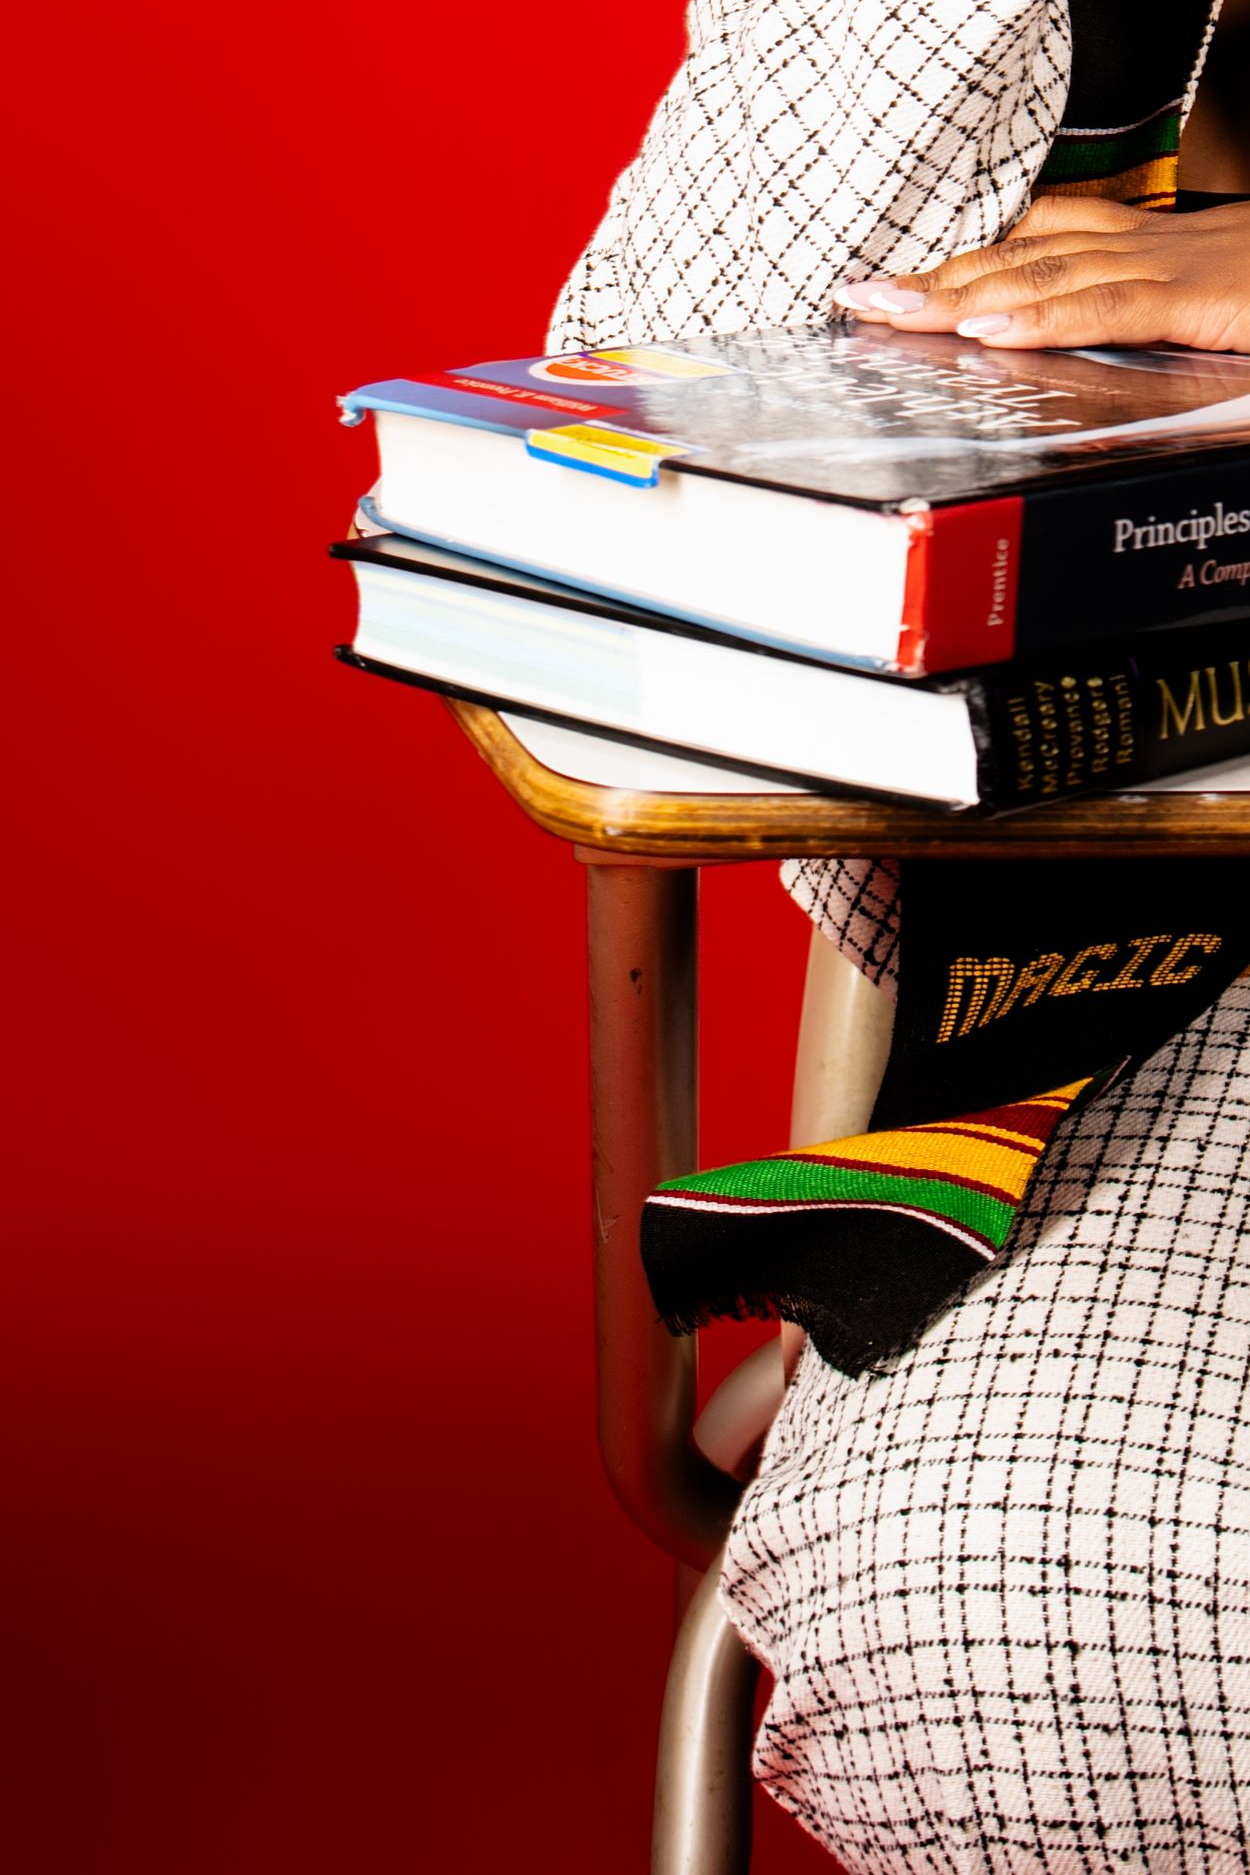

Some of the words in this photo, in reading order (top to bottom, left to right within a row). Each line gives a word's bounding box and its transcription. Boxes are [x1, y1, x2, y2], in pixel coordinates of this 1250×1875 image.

[731, 335, 1079, 409] Training
[742, 363, 1084, 430] Athletic
[1112, 501, 1250, 554] Principles
[985, 536, 1010, 628] Prentice
[1177, 563, 1196, 590] A
[1006, 696, 1036, 792] Kendall
[1033, 680, 1060, 795] McCreary
[1059, 675, 1086, 787] Provance
[1086, 676, 1113, 775] Rodgers
[934, 932, 1222, 1044] MAGIC
